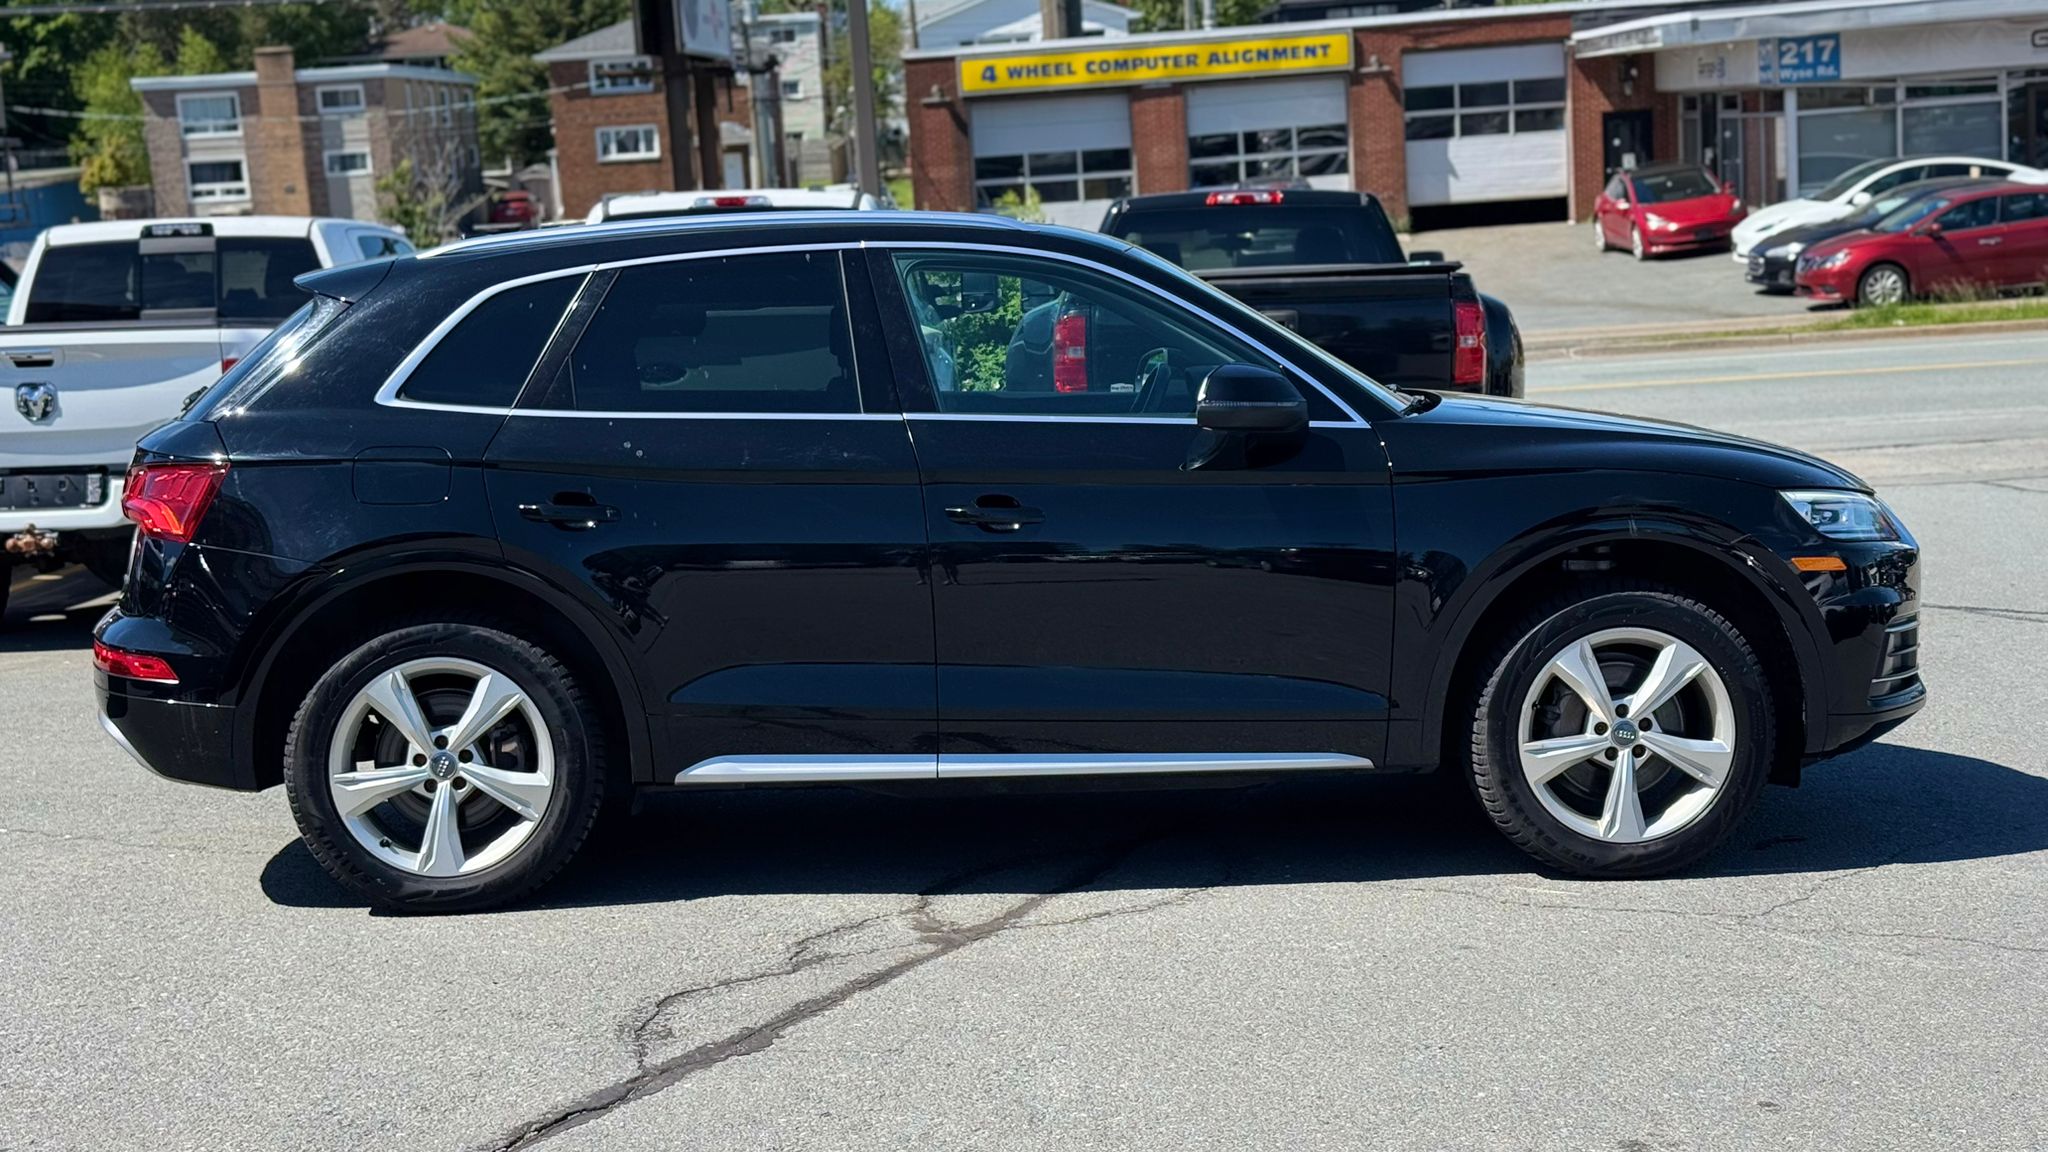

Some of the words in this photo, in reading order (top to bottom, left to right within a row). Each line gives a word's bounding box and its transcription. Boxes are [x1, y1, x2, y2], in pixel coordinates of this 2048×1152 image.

[980, 65, 997, 83] 4
[1007, 62, 1078, 80] WHEEL
[1086, 53, 1199, 75] COMPUTER
[1207, 43, 1332, 67] ALIGNMENT
[1781, 39, 1836, 65] 217
[1780, 68, 1813, 81] Wyse
[1816, 65, 1838, 77] Rd.
